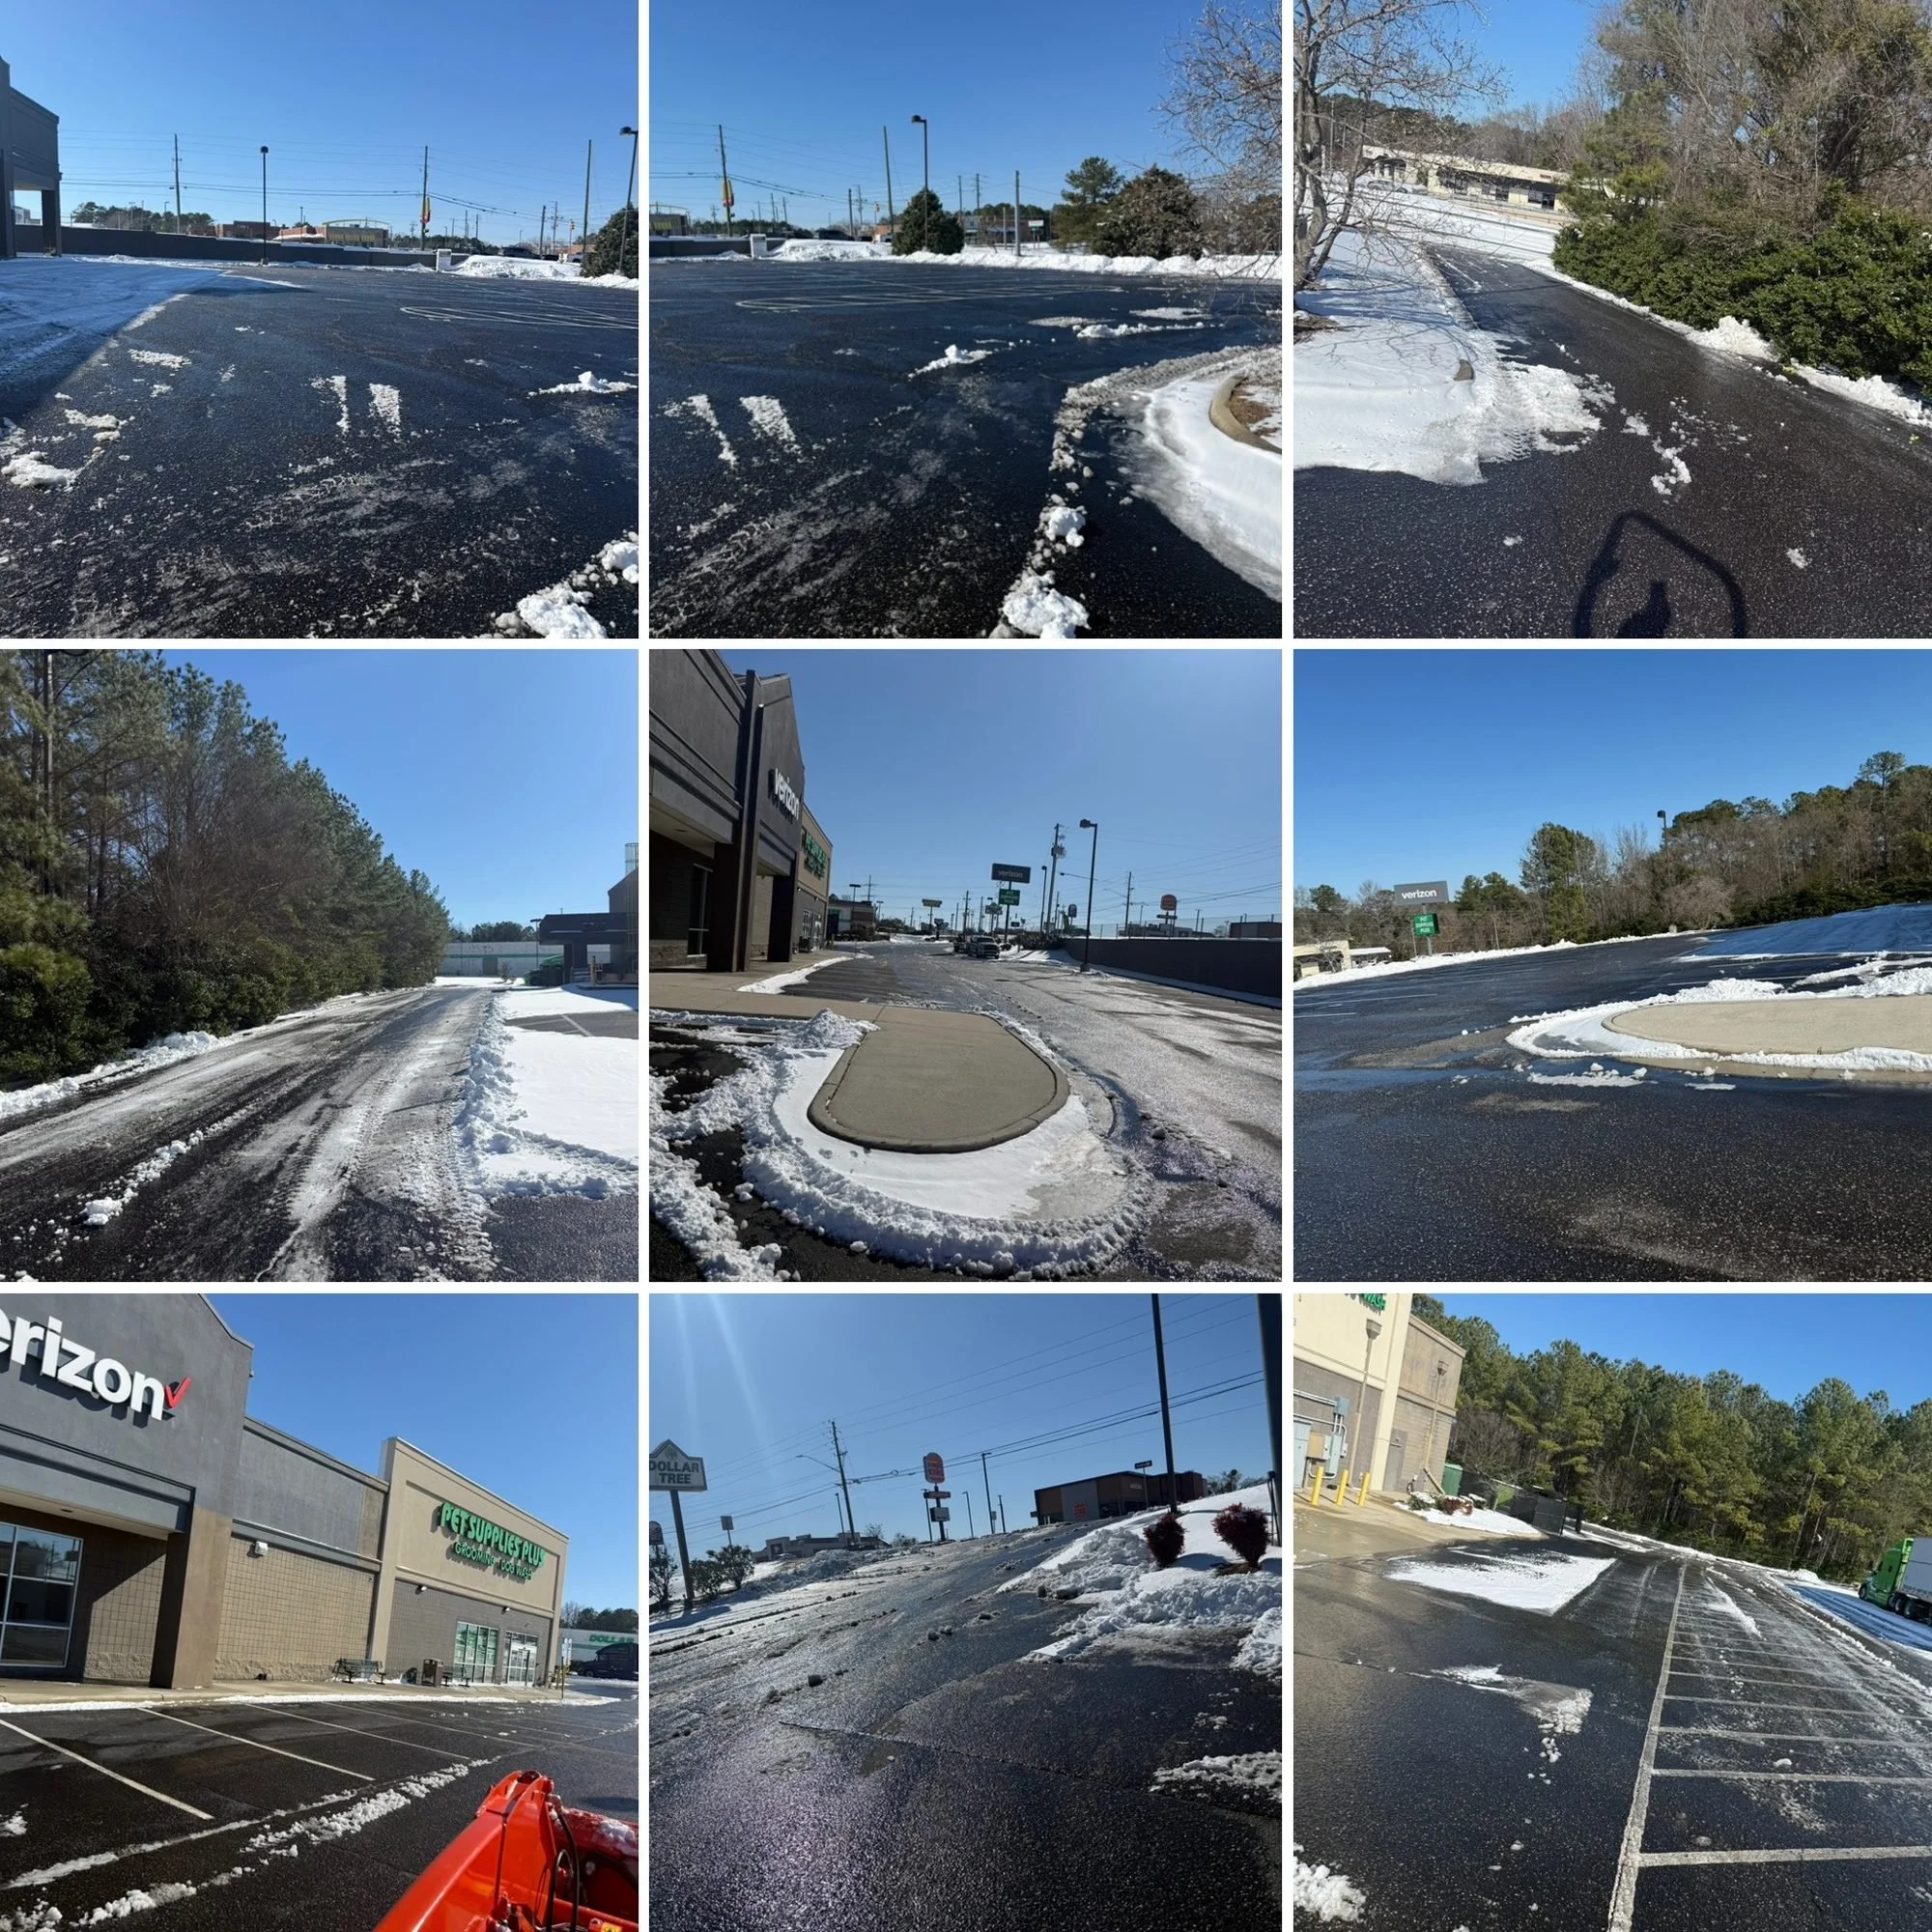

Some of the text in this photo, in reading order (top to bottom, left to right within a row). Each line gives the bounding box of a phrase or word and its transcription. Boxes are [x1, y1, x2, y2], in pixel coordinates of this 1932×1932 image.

[775, 768, 800, 820] verizon
[1401, 889, 1437, 899] verizon
[649, 1460, 699, 1473] DOLLAR
[659, 1473, 692, 1484] TREE
[440, 1502, 547, 1569] PET SUPPLIES PLUS
[455, 1542, 497, 1567] GROOMING
